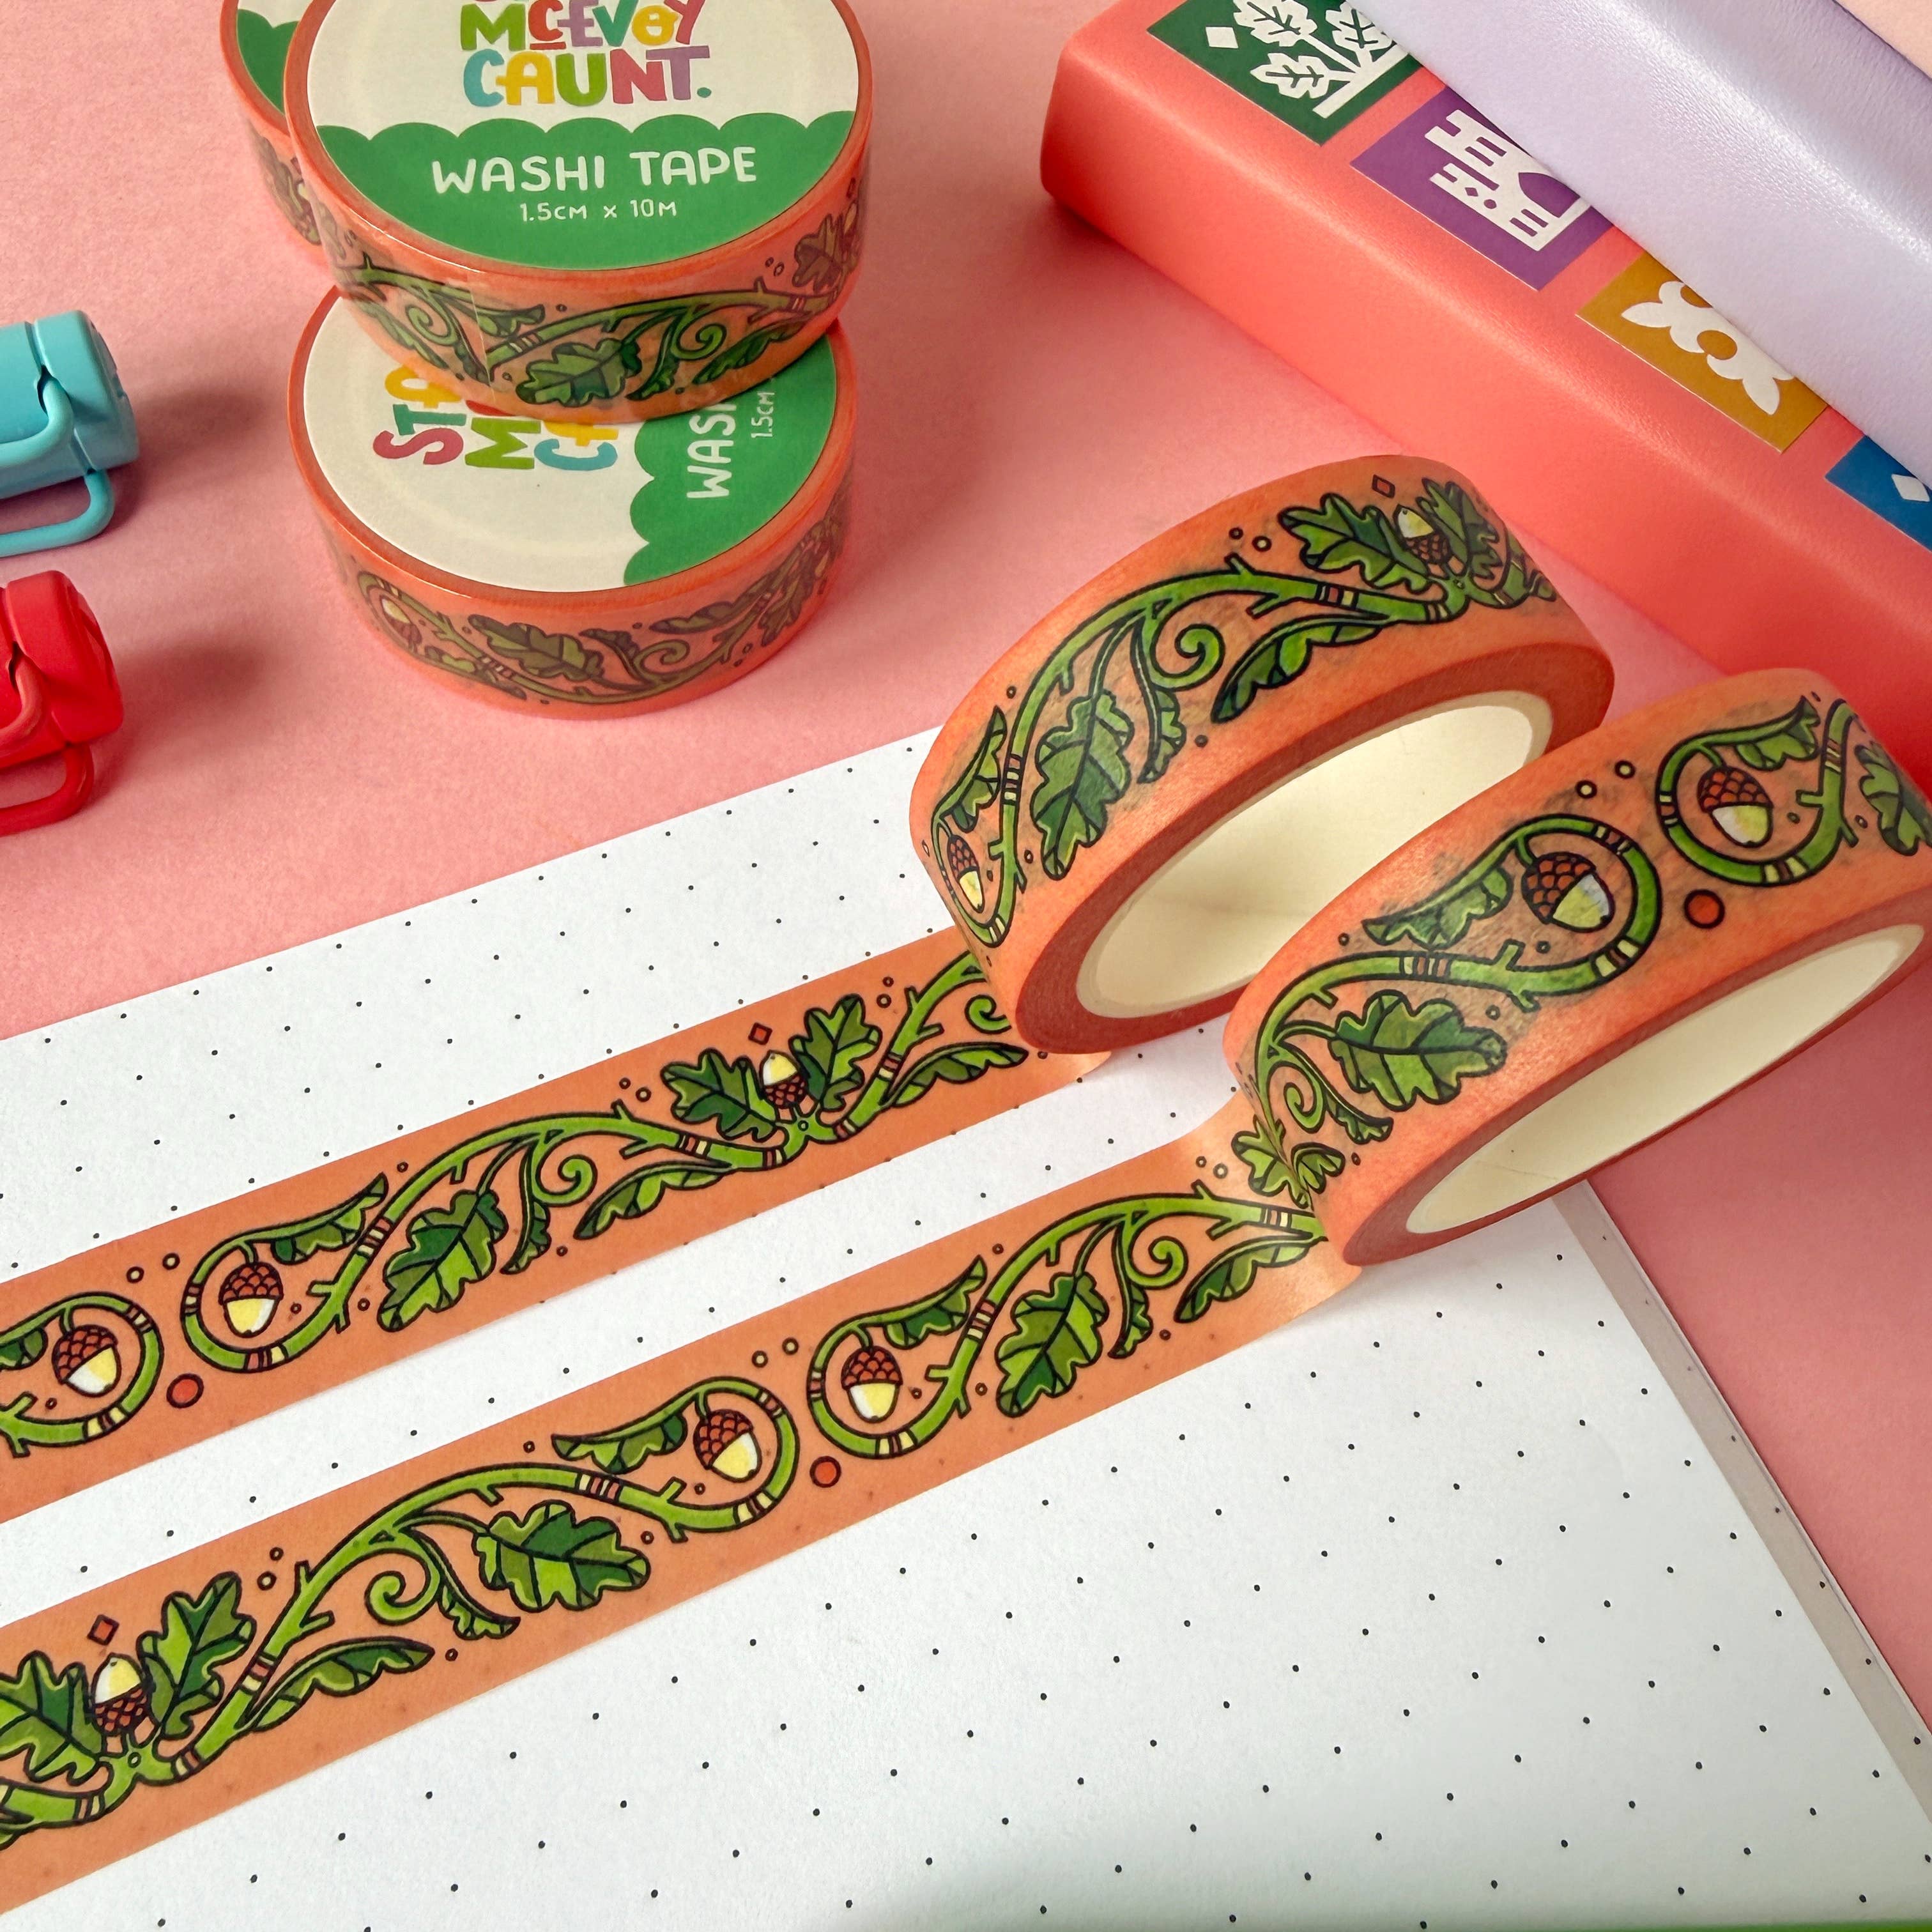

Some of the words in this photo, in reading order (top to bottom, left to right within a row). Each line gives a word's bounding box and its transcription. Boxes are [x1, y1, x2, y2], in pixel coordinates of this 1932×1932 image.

[463, 45, 712, 107] CAUNT.
[432, 155, 605, 194] WASHI
[629, 146, 757, 186] TAPE
